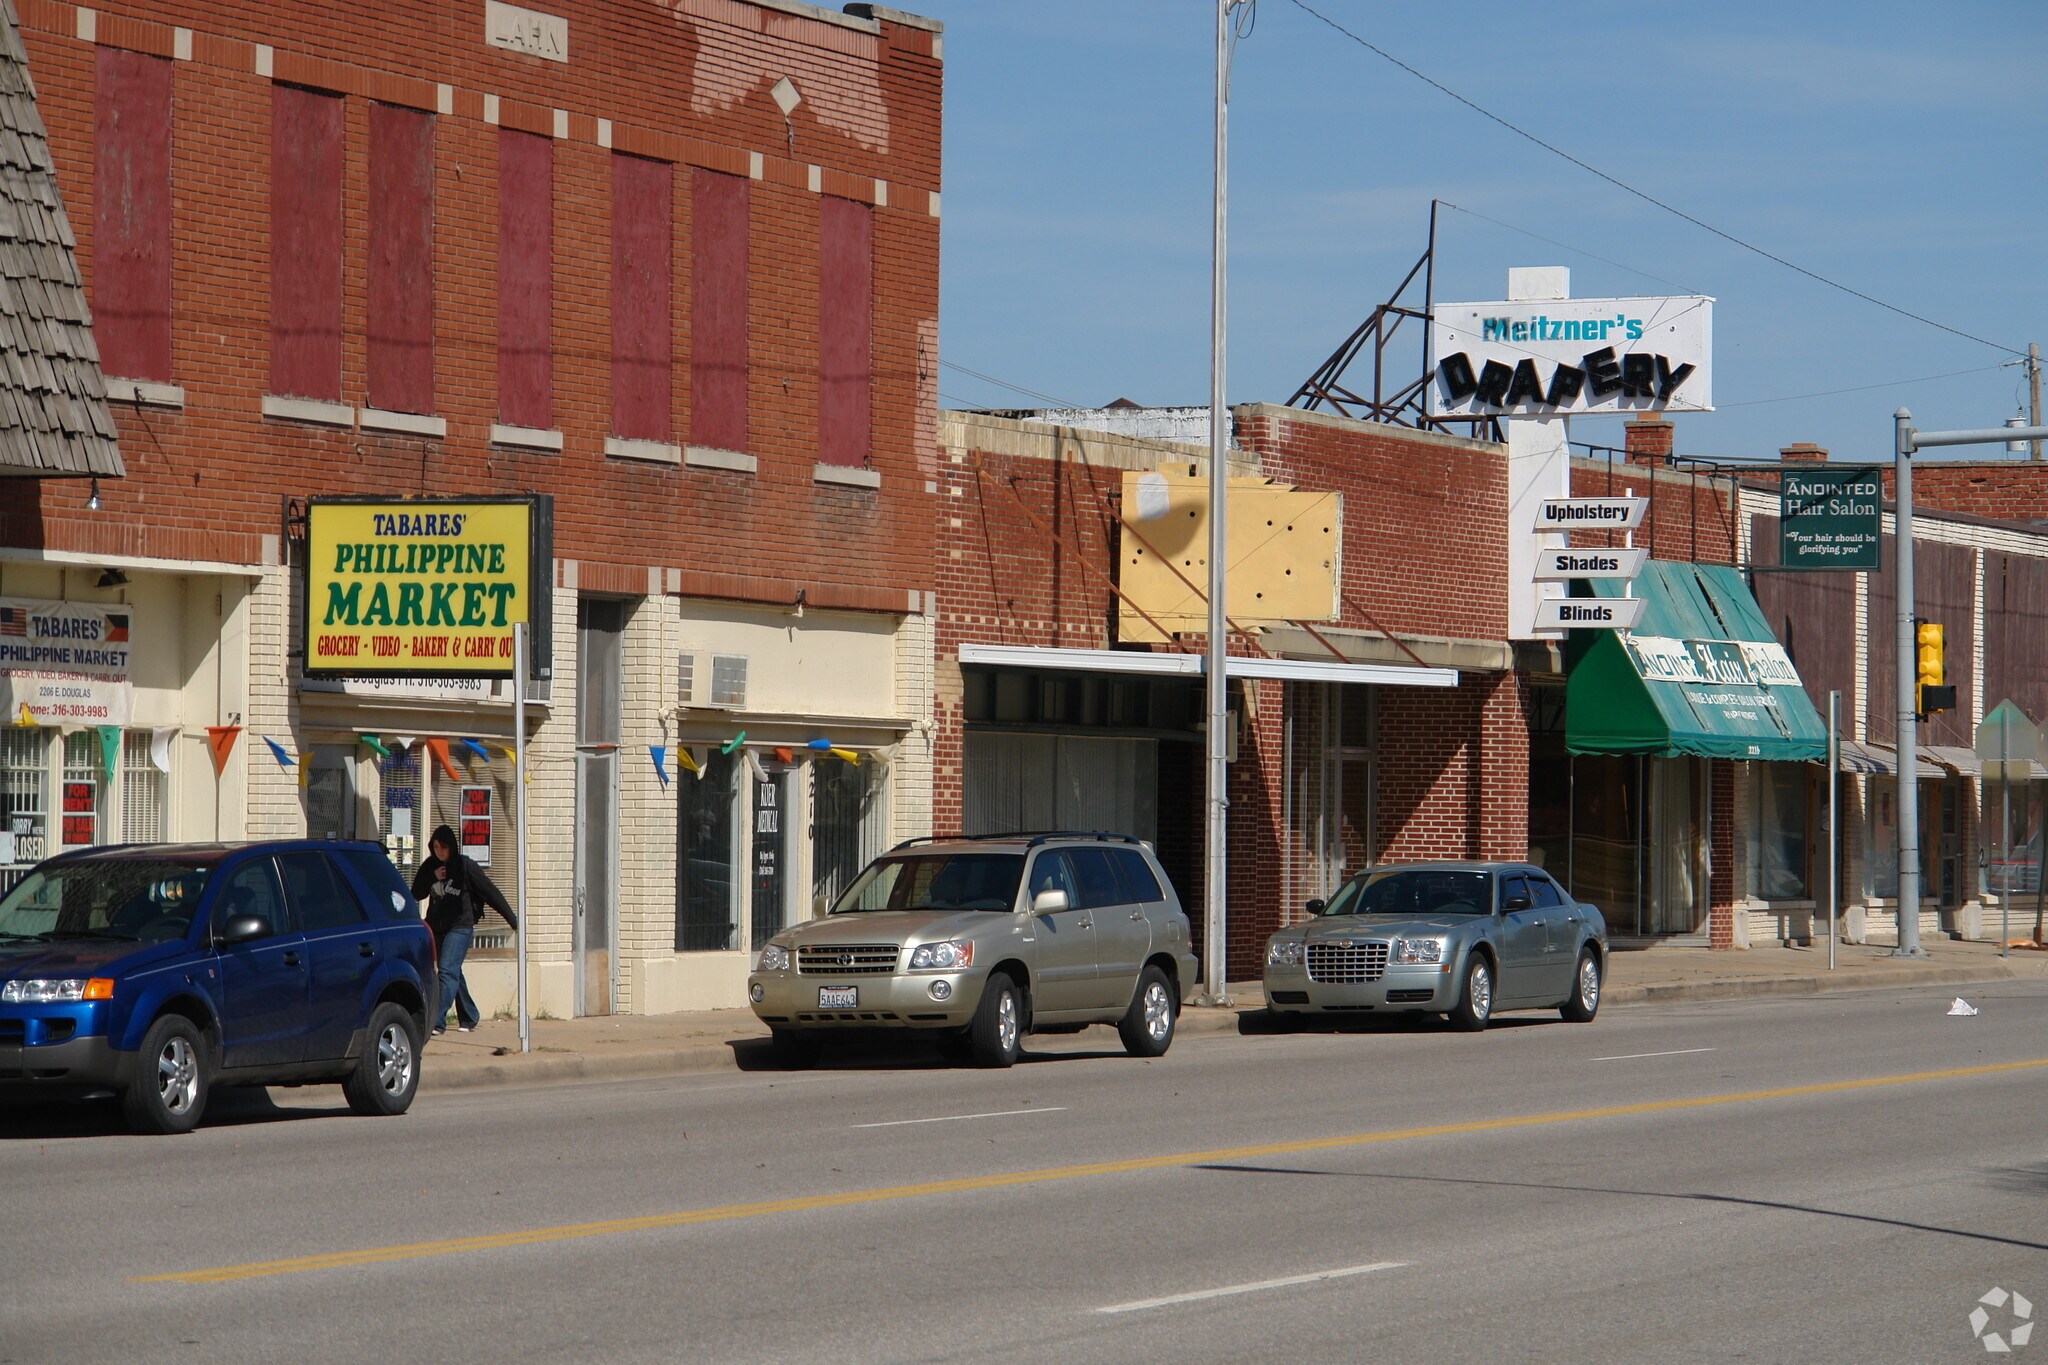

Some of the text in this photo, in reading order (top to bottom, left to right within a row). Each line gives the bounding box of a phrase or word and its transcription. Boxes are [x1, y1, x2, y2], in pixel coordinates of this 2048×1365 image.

[1482, 314, 1643, 342] Meitzner's
[1439, 346, 1697, 408] DRAPERY
[1787, 482, 1876, 495] ANOINTED
[1546, 504, 1629, 522] Upholstery
[1786, 499, 1875, 516] Hair Salon
[373, 514, 467, 536] TABARES'
[1815, 534, 1833, 542] hair
[1835, 534, 1863, 542] should
[1865, 534, 1876, 542] be
[1799, 544, 1841, 555] glorifying
[334, 543, 505, 574] PHILIPPINE
[1556, 556, 1618, 570] Shades
[323, 582, 516, 627] MARKET
[1560, 606, 1612, 620] Blinds
[32, 616, 101, 640] TABARES'
[318, 635, 360, 657] GROCERY
[372, 636, 400, 657] VIDEO
[411, 636, 450, 657] BAKERY
[452, 637, 461, 657] &
[464, 636, 496, 658] CARRY
[499, 636, 513, 658] OU
[0, 645, 128, 666] PHILIPPINE MARKET
[1696, 644, 1750, 683] Hair
[58, 671, 83, 681] BAKERY
[90, 672, 111, 682] CARRY
[112, 674, 127, 684] OUT
[39, 686, 91, 698] 2206 E. DOUGLAS
[51, 704, 108, 718] 316-303-9983
[68, 784, 88, 797] FOR
[467, 790, 484, 802] FOR
[63, 798, 93, 811] RENT
[463, 803, 488, 815] RENT
[12, 818, 33, 835] SORRY
[76, 817, 94, 833] SALE
[474, 821, 490, 834] SALE
[15, 836, 44, 860] LOSED
[821, 994, 855, 1005] 5AAE643
